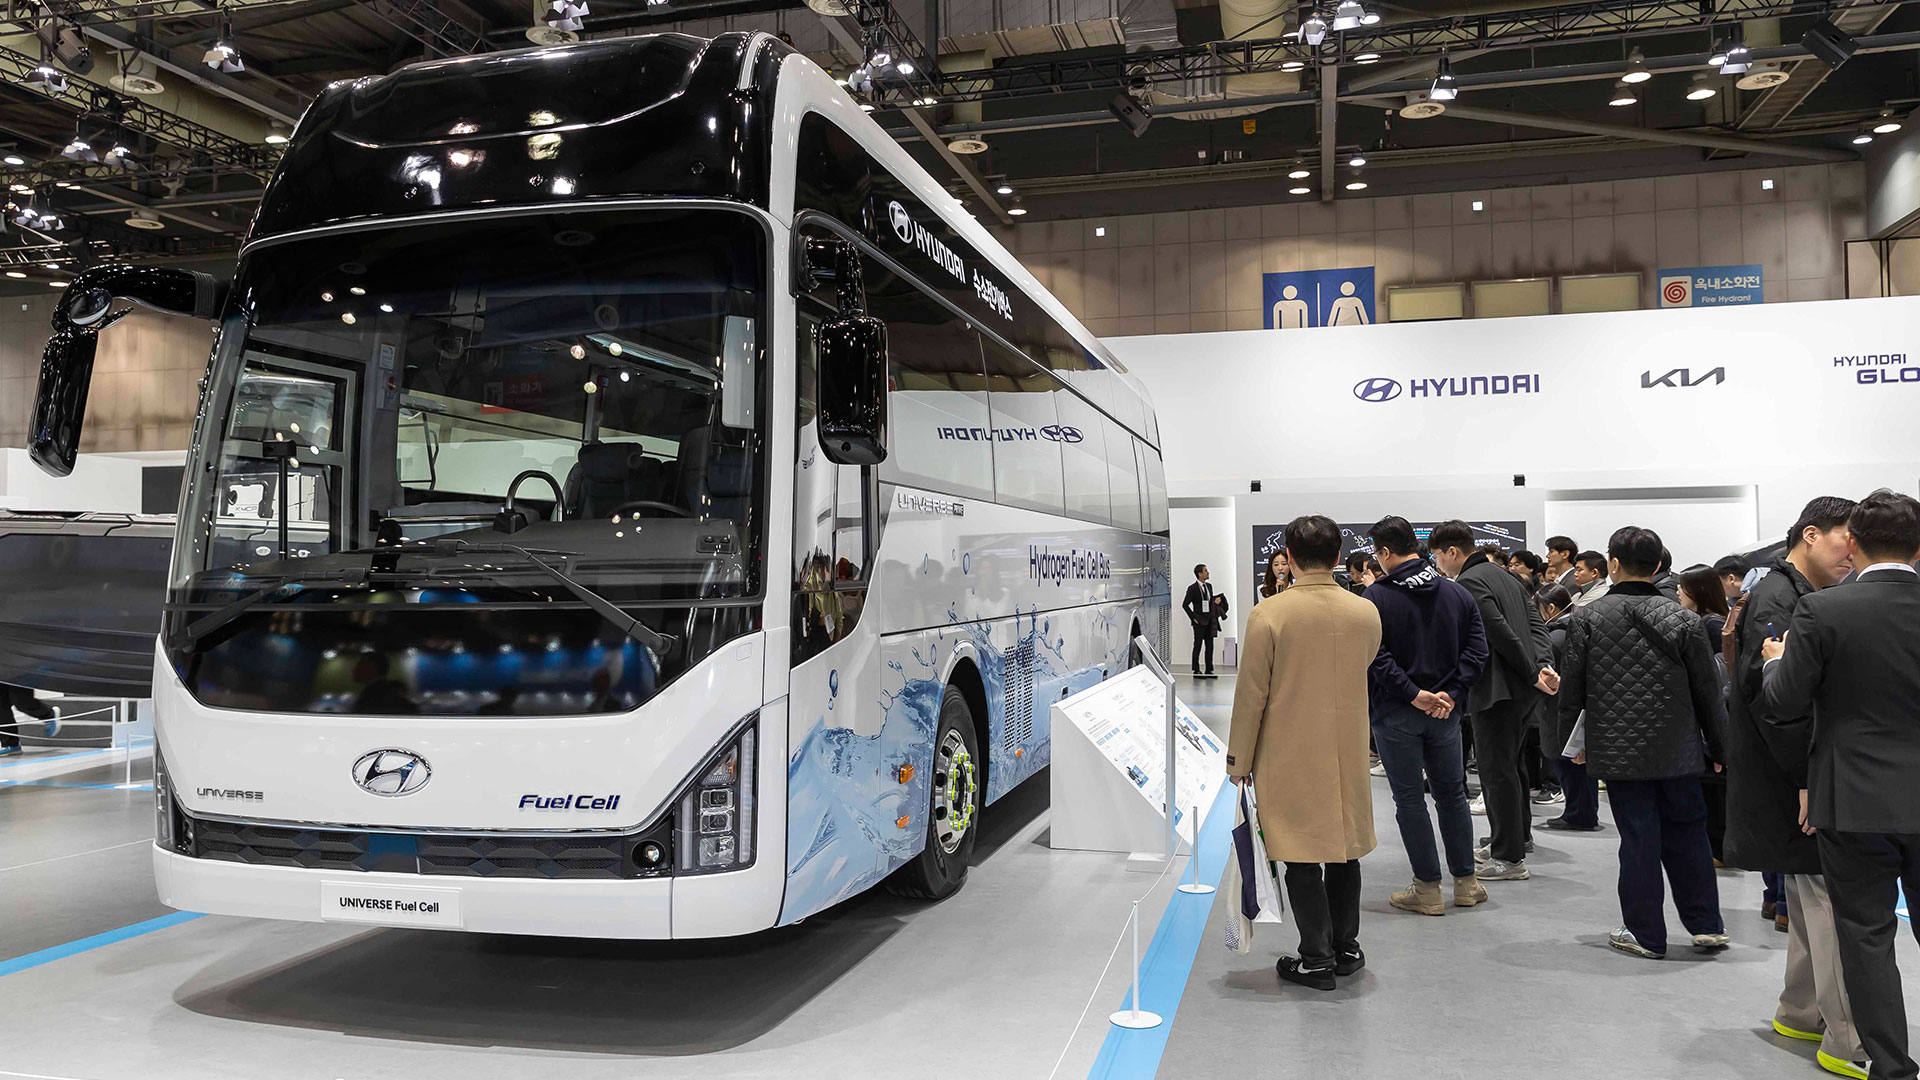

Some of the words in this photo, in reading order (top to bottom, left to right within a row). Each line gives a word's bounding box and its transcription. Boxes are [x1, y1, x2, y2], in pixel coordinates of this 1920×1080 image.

[914, 220, 966, 284] HYUNDAI
[1694, 275, 1760, 290] 옥내소화전
[973, 268, 1013, 321] 수소전기버스
[1718, 294, 1751, 303] Hydrant
[1833, 353, 1906, 367] HYUNDAI
[1410, 374, 1539, 397] HYUNDAI
[1641, 366, 1725, 389] KIA
[897, 493, 953, 515] UNIVERSE
[1029, 545, 1071, 587] Hydrogen
[1071, 549, 1086, 579] Fuel
[1086, 551, 1099, 579] Cell
[1099, 552, 1110, 579] Bus
[196, 788, 263, 800] UNIVERSE
[518, 794, 573, 809] Fuel
[574, 795, 620, 810] Cell
[339, 897, 393, 910] UNIVERSE
[395, 901, 417, 911] Fuel
[419, 902, 439, 912] Cell
